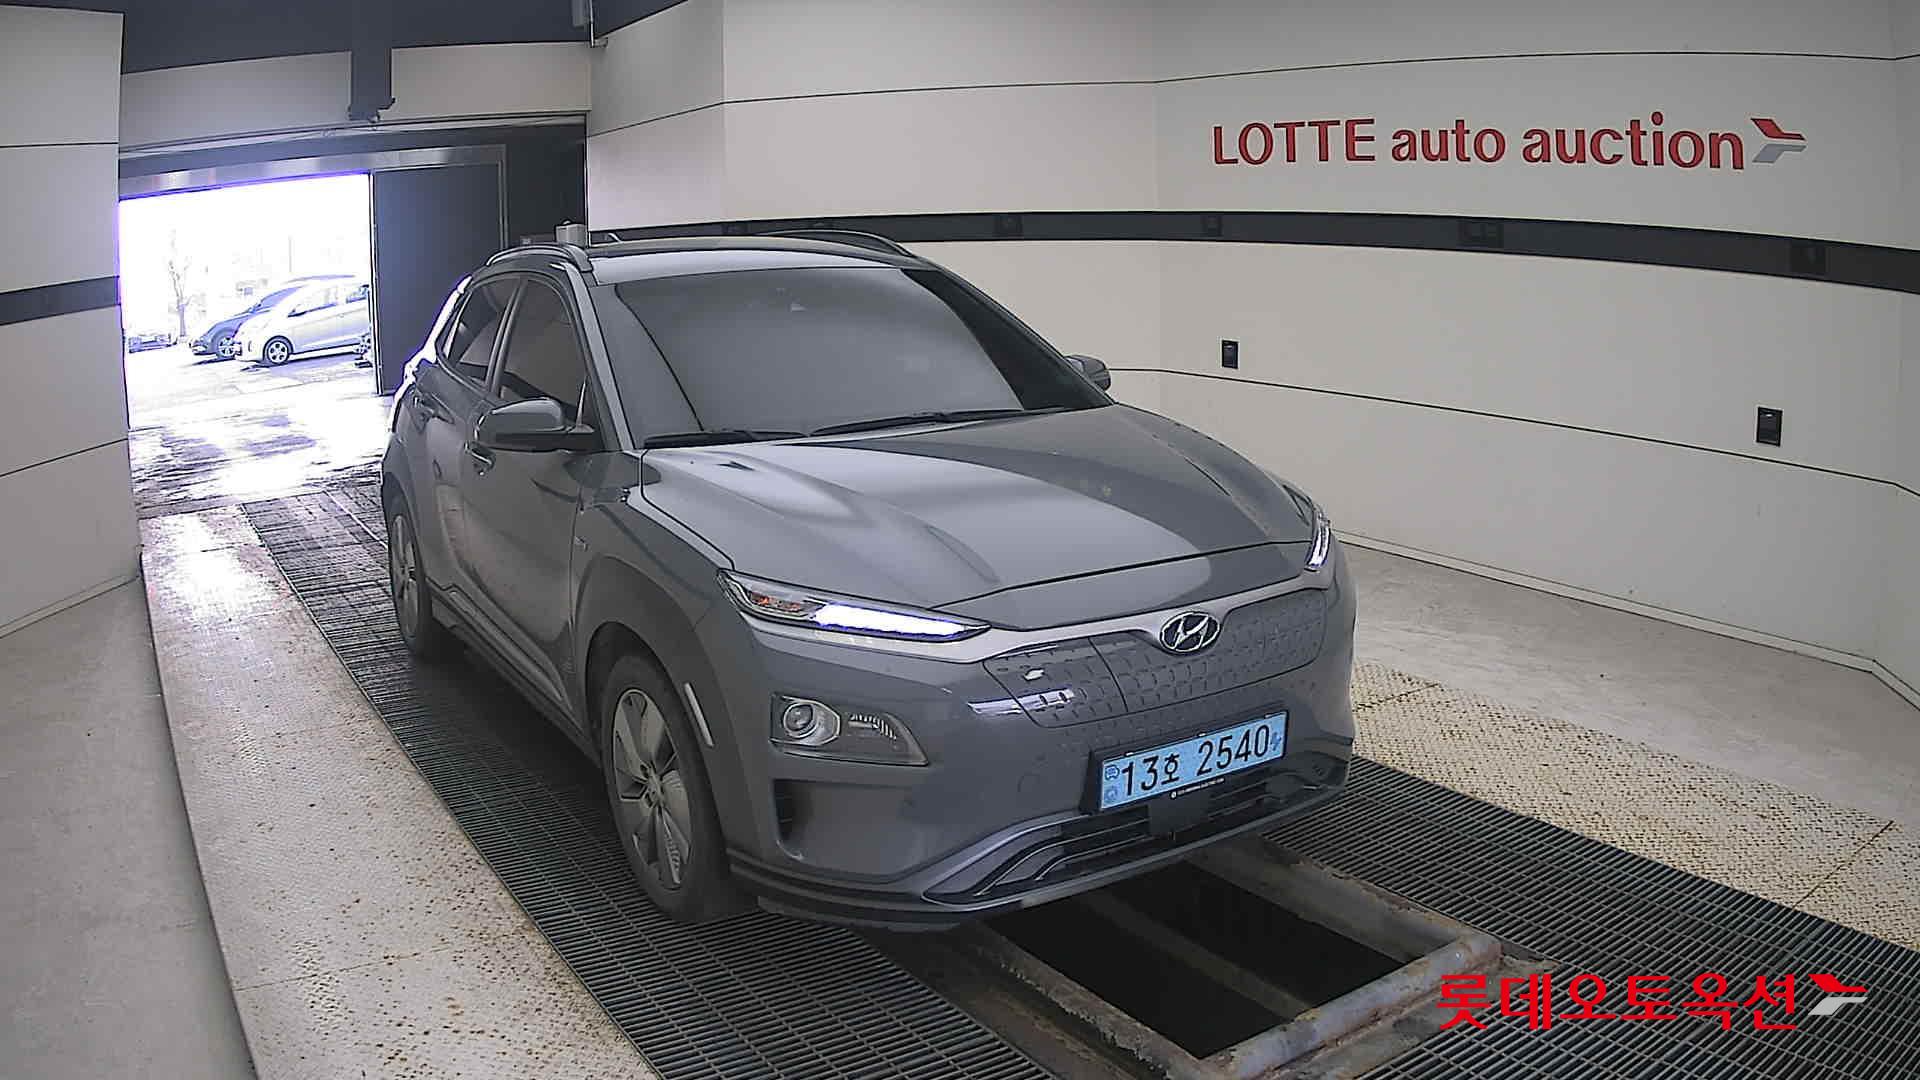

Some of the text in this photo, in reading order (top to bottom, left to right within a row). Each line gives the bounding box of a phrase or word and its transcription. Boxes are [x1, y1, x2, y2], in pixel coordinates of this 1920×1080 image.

[1213, 111, 1745, 170] LOTTE auto auction
[1121, 724, 1270, 796] 13호 2540
